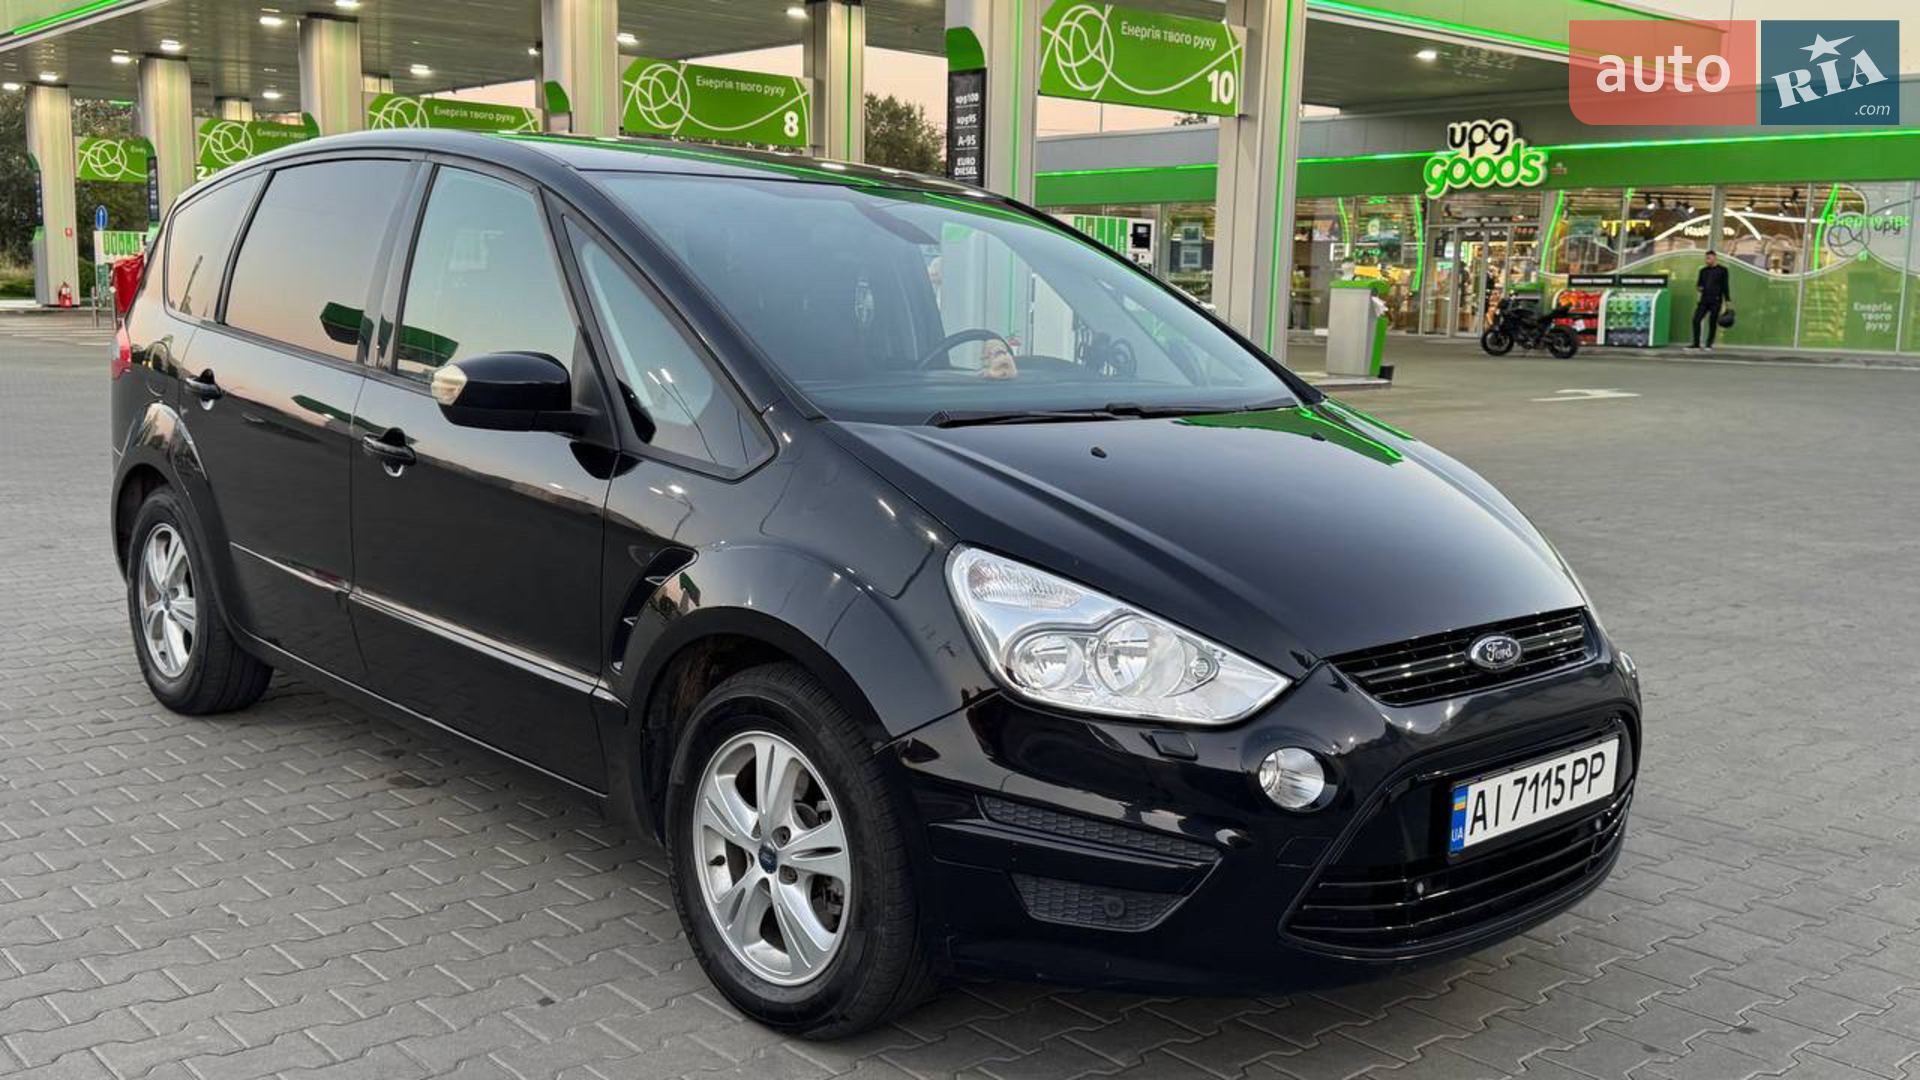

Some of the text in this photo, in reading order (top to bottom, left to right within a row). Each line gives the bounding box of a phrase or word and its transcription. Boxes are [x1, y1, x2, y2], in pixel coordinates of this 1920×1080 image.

[1121, 21, 1216, 51] Енергія твого руху
[696, 75, 786, 97] Енергія твого руху
[1207, 70, 1235, 104] 10
[783, 111, 799, 138] 8
[1449, 120, 1511, 159] upg
[954, 166, 977, 176] DIESEL
[957, 157, 976, 166] EURO
[1424, 142, 1543, 197] goods
[1486, 641, 1513, 662] Ford
[1470, 784, 1502, 836] AI
[1452, 827, 1464, 841] UA
